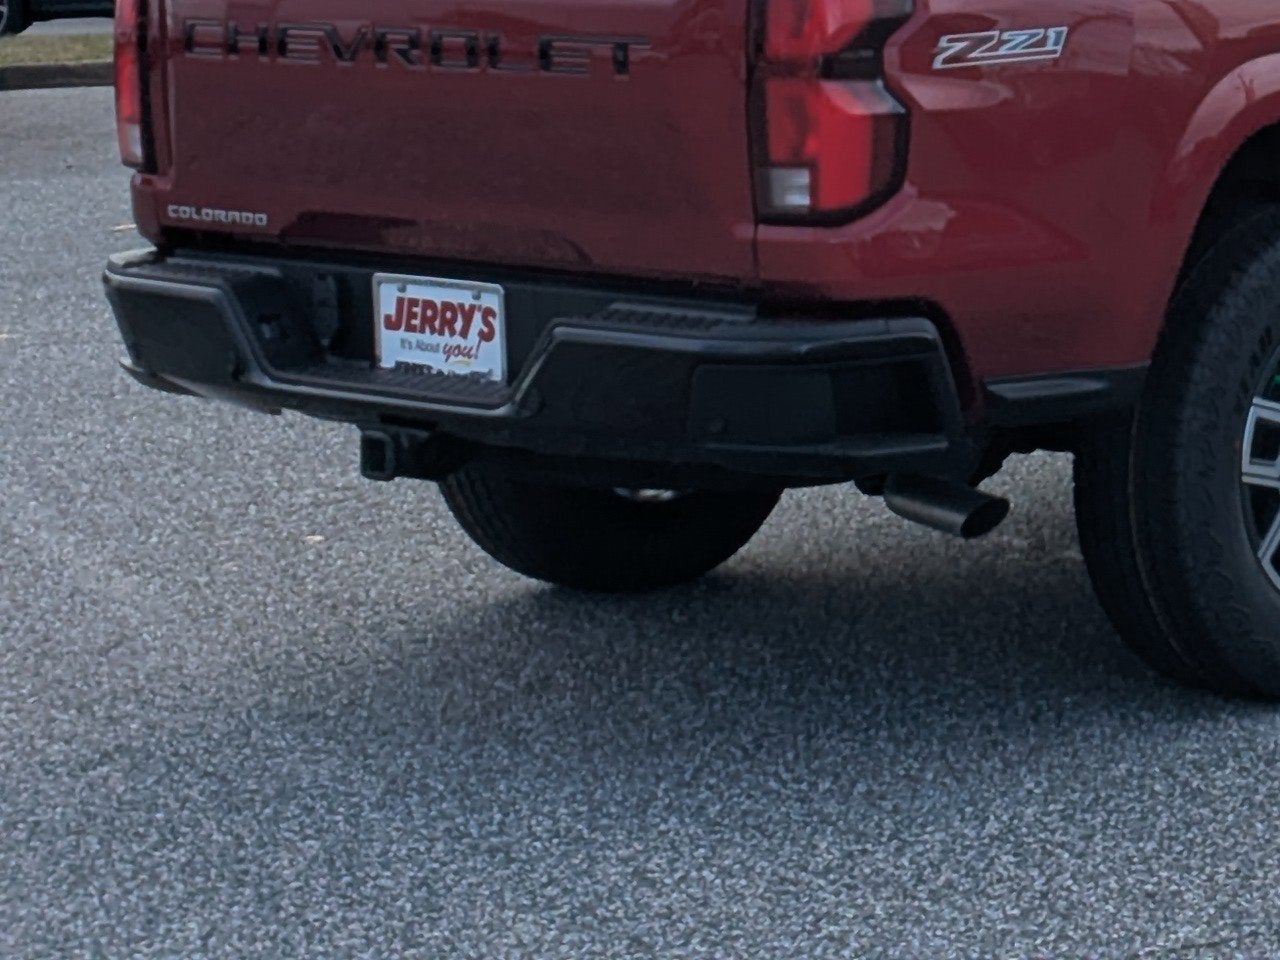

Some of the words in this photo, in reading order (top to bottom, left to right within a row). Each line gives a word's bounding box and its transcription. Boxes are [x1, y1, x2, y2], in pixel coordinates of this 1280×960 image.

[184, 20, 652, 77] CHEVROLET
[167, 204, 268, 226] COLORADO
[383, 295, 498, 343] JERRY'S
[442, 341, 482, 363] you!
